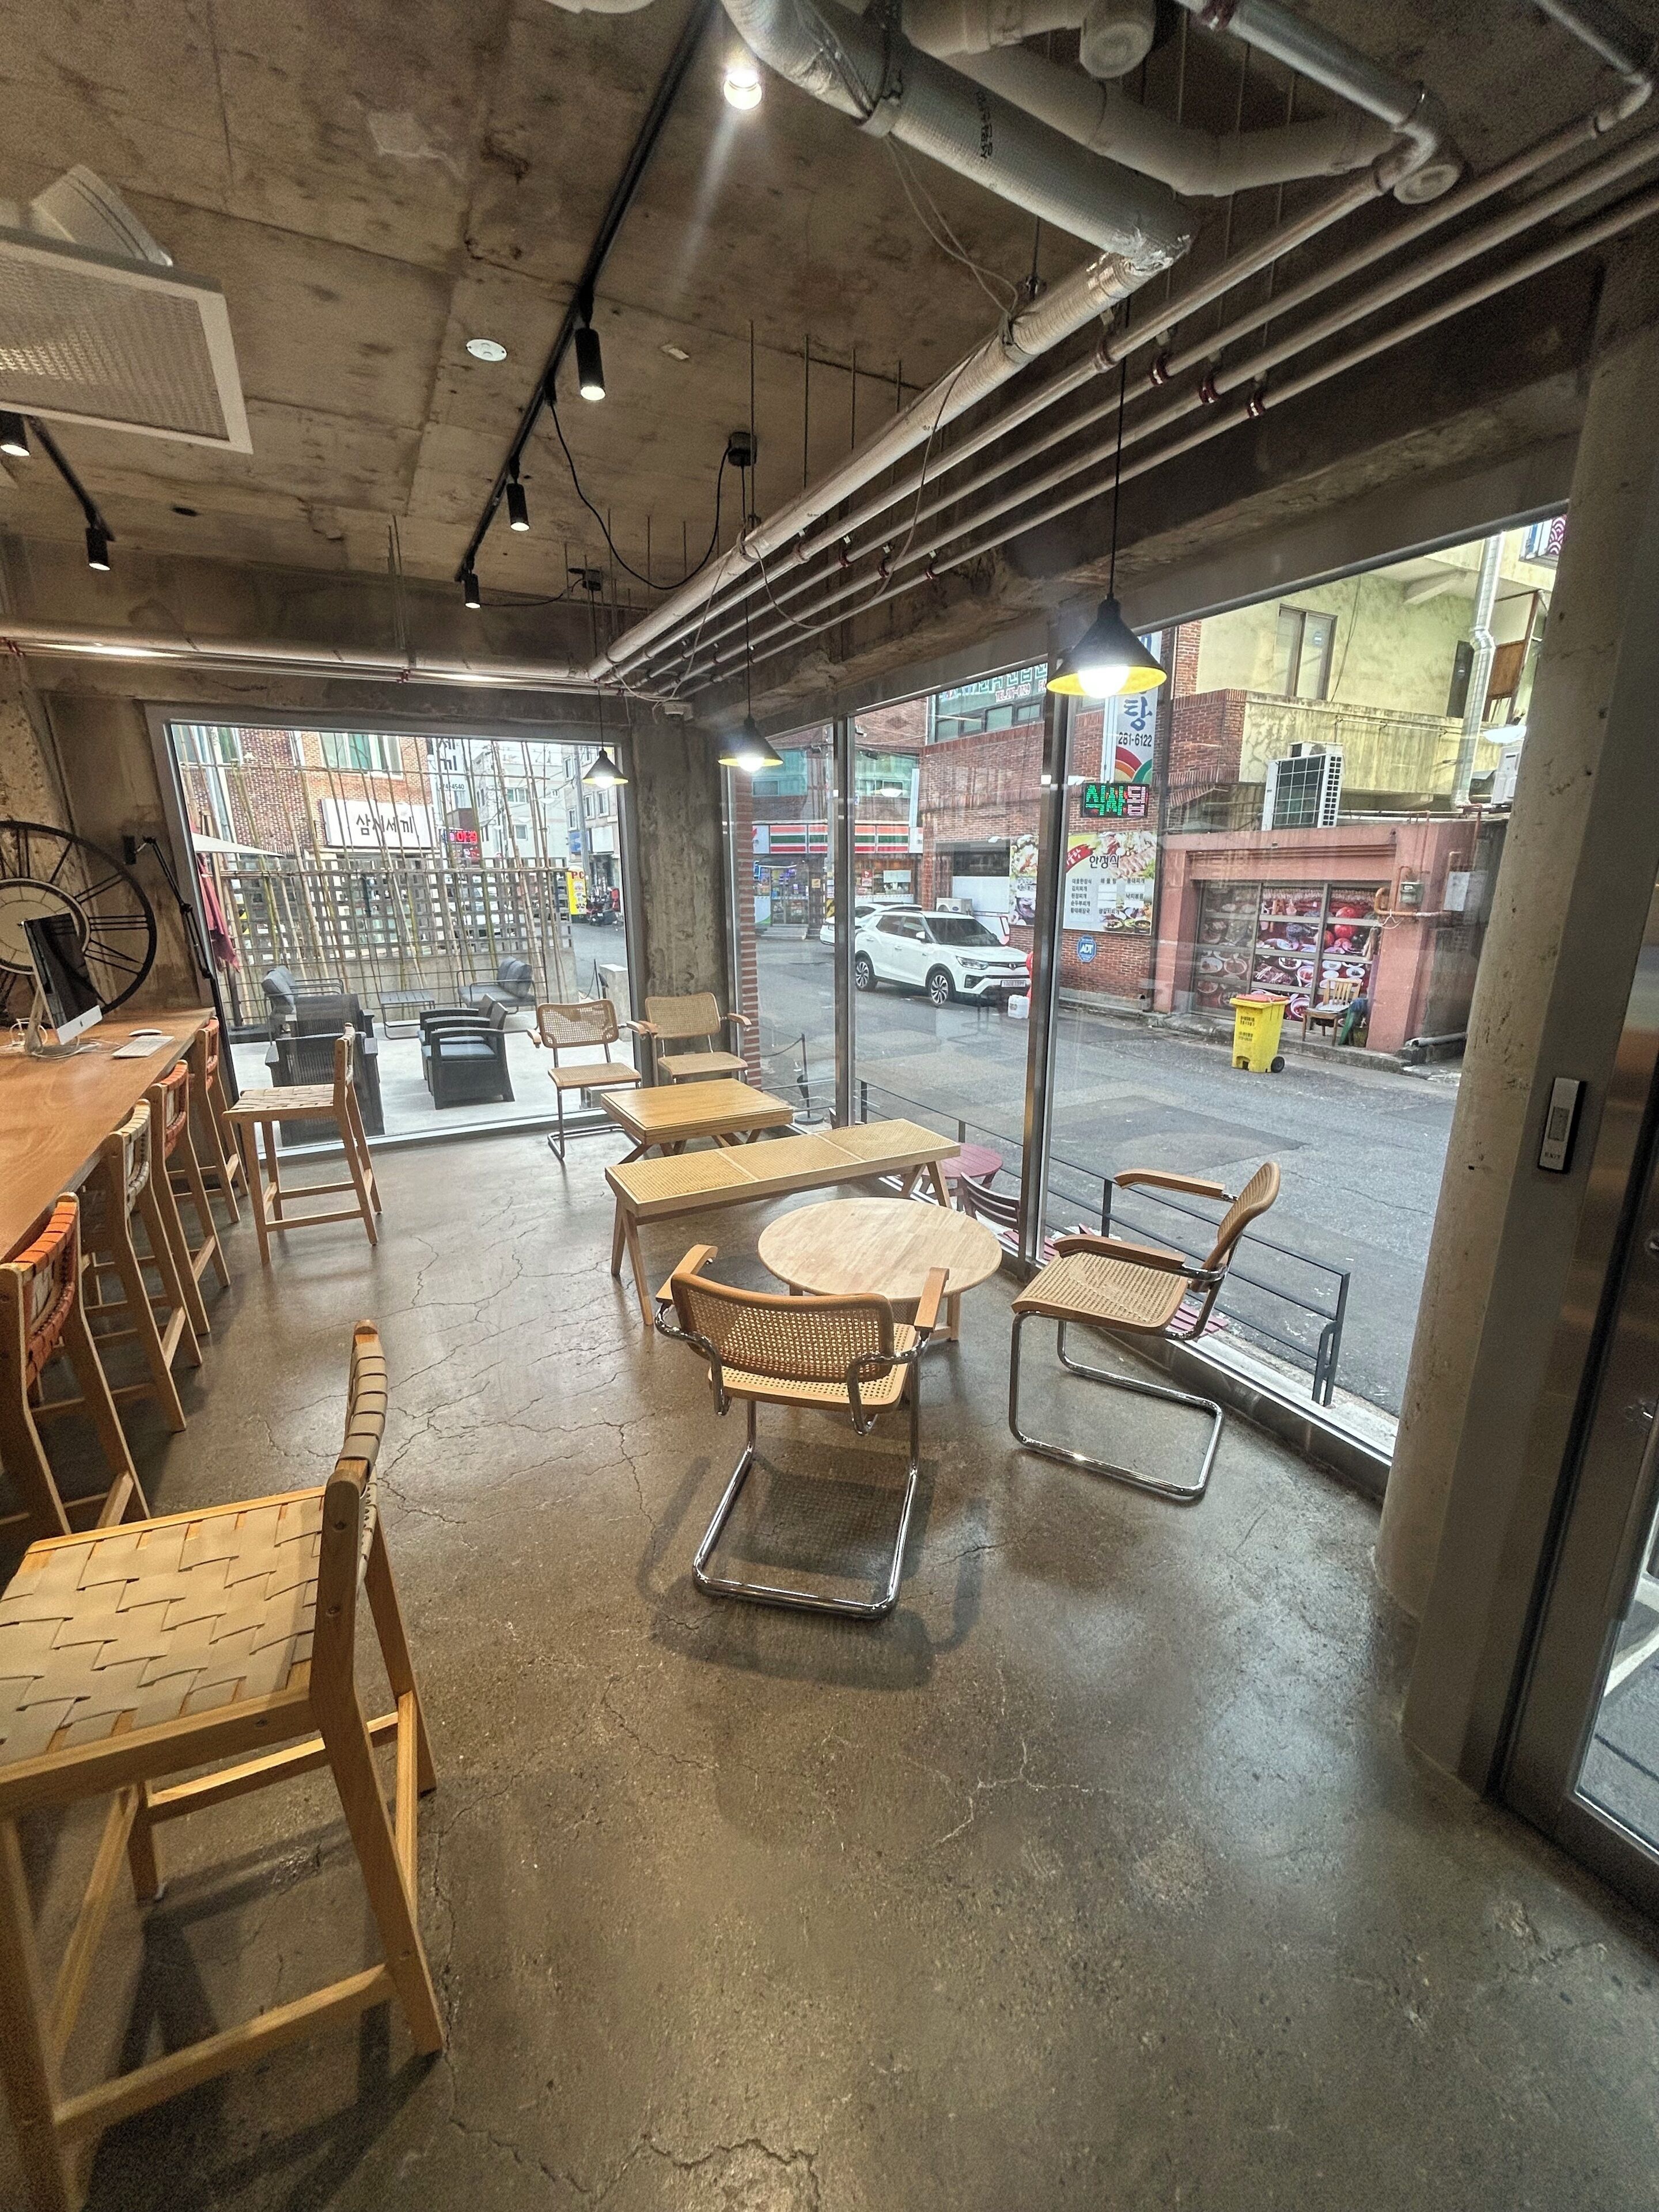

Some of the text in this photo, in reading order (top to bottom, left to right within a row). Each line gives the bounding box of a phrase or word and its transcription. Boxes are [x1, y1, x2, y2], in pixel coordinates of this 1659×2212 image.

[1118, 732, 1153, 747] 281-6122
[356, 814, 413, 835] 삼시세끼
[571, 871, 584, 879] PC
[1080, 944, 1094, 954] ADT
